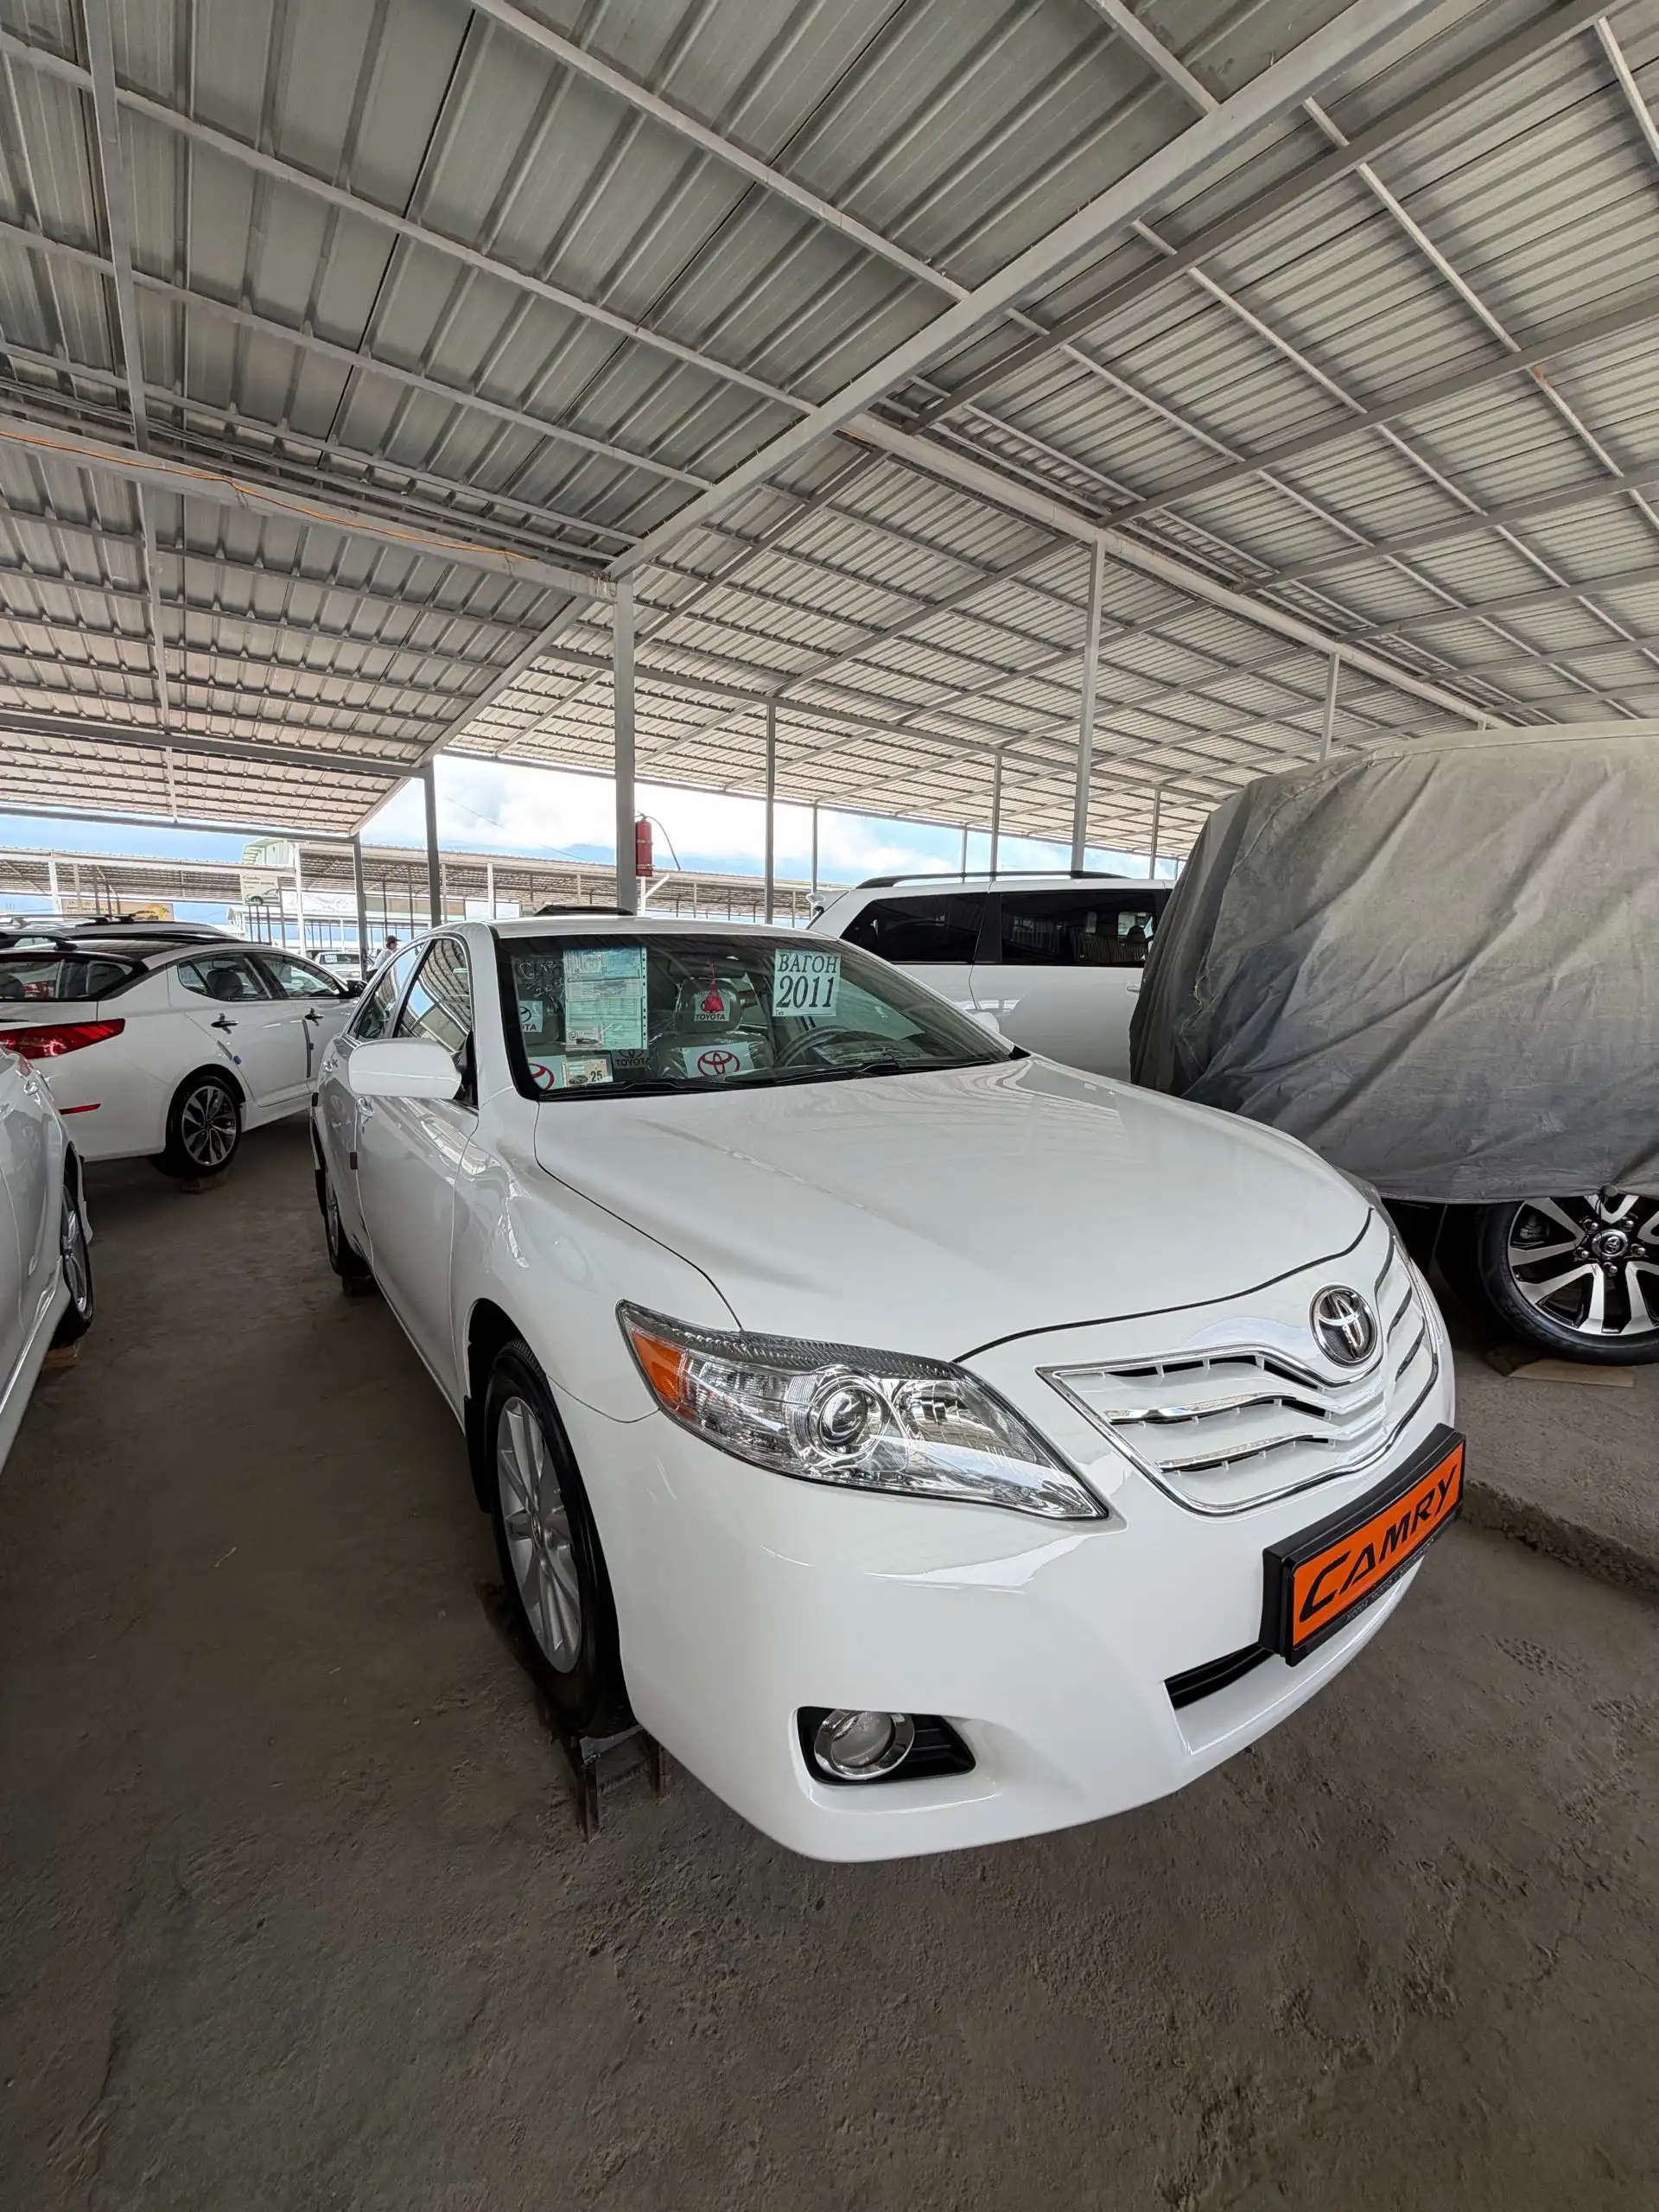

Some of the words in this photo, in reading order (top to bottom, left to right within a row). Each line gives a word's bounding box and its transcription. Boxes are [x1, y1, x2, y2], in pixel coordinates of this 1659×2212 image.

[777, 954, 838, 974] ВАГОН
[776, 976, 835, 1008] 2011
[590, 1070, 603, 1082] 25
[1299, 1465, 1458, 1622] CAMRY
